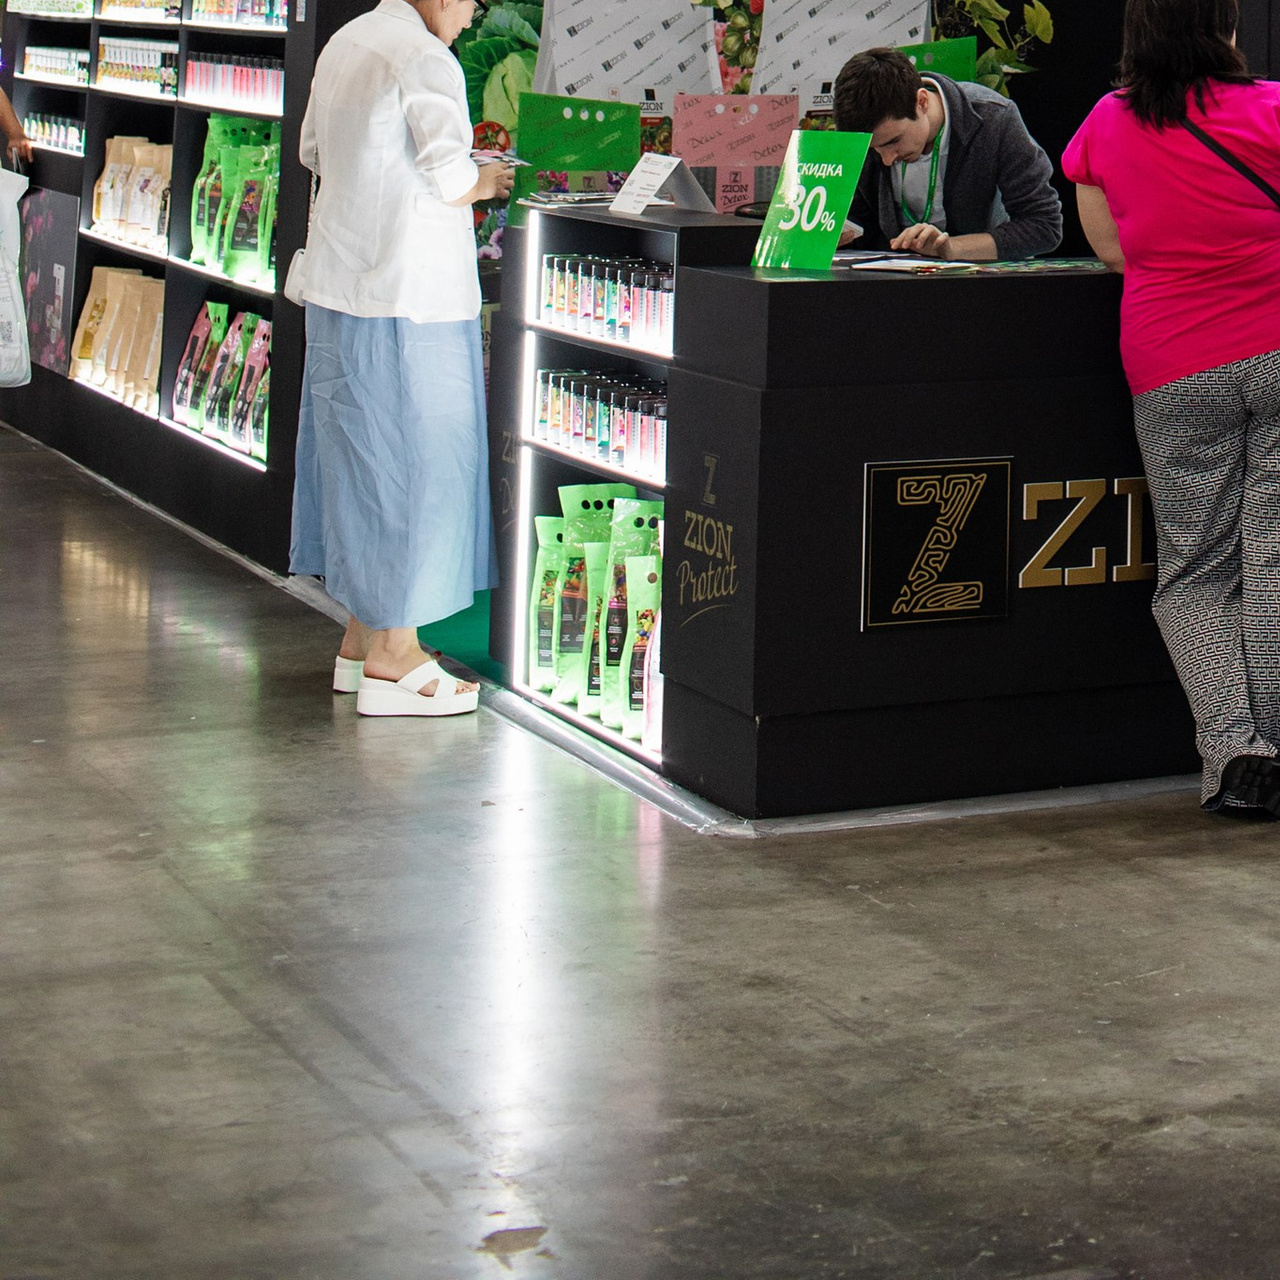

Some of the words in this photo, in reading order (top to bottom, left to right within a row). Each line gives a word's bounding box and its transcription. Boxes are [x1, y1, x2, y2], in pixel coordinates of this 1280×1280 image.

[639, 102, 663, 111] ZION
[797, 162, 842, 178] СКИДКА
[722, 185, 748, 193] ZION
[720, 194, 748, 205] Detox
[683, 510, 734, 560] ZION
[676, 555, 738, 606] Protect
